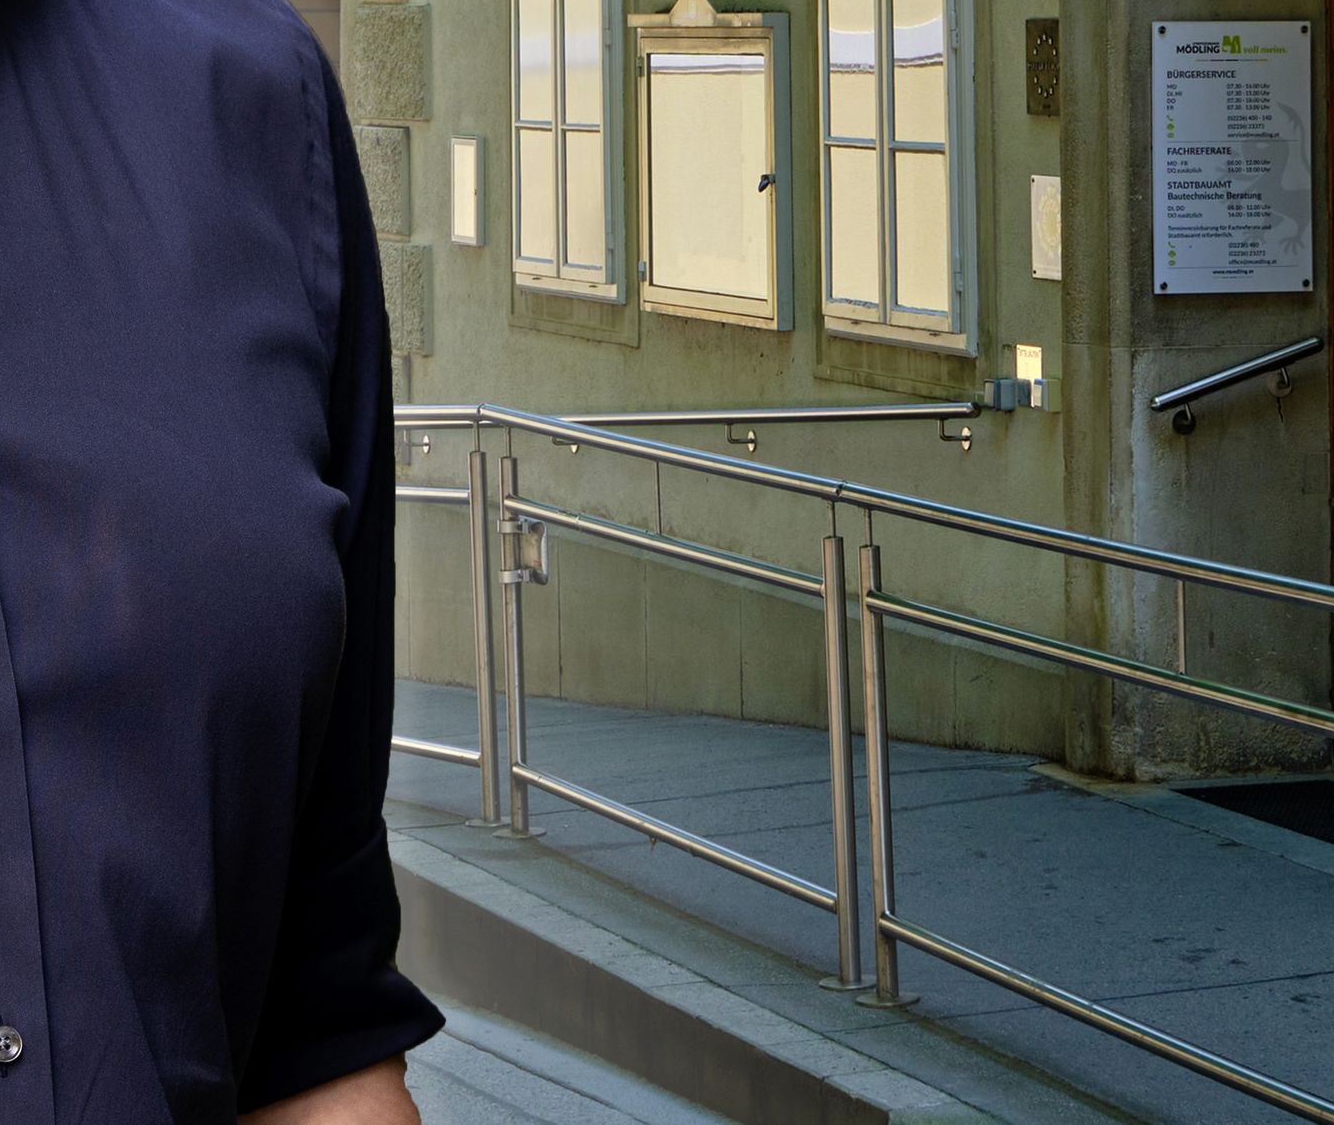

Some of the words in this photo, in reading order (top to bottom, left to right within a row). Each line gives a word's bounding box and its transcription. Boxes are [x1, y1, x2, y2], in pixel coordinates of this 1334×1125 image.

[1176, 44, 1220, 54] MÖDLING
[1167, 69, 1236, 79] BÜRGERSERVICE
[1167, 147, 1232, 155] FACHREFERATE
[1167, 180, 1232, 189] STADTBAUAMT
[1167, 192, 1224, 201] Bautechnische
[1226, 191, 1262, 201] Beratung
